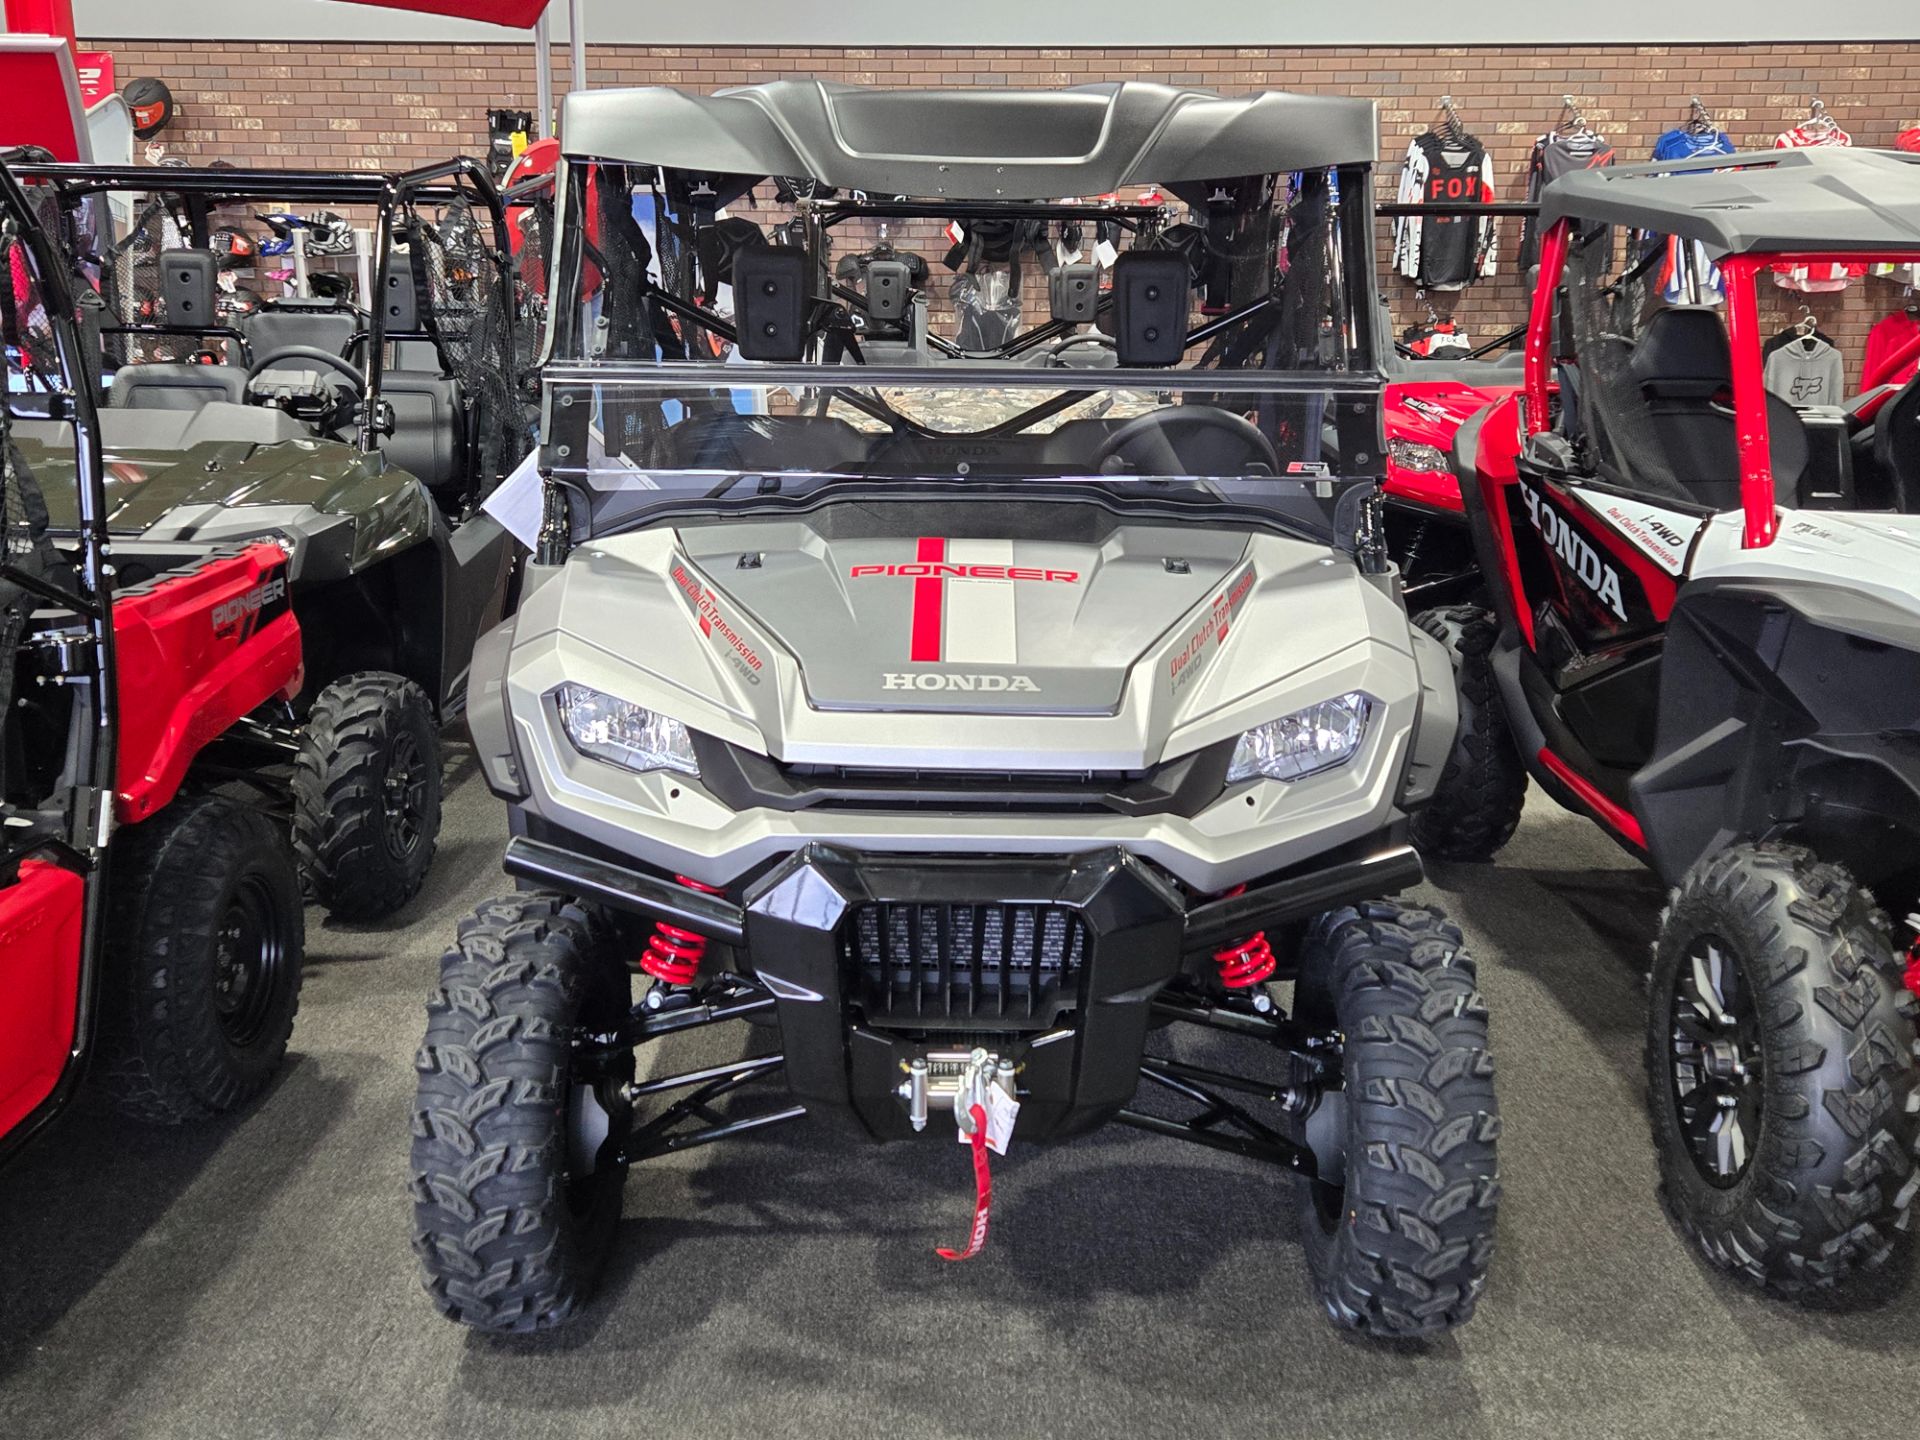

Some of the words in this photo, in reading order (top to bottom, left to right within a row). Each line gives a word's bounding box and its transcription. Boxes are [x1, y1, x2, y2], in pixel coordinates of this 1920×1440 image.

[1431, 175, 1477, 199] FOX
[1441, 336, 1457, 345] FOX
[850, 564, 1080, 583] PIONEER
[1519, 479, 1628, 623] HONDA
[211, 577, 285, 630] PIONEER
[672, 565, 692, 587] Dual
[686, 583, 711, 613] Clutch
[706, 606, 763, 671] Transmission
[1170, 643, 1191, 678] Dual
[1191, 618, 1215, 655] Clutch
[1213, 571, 1254, 627] Transmission
[882, 672, 1042, 692] HONDA
[968, 1207, 989, 1255] HON
